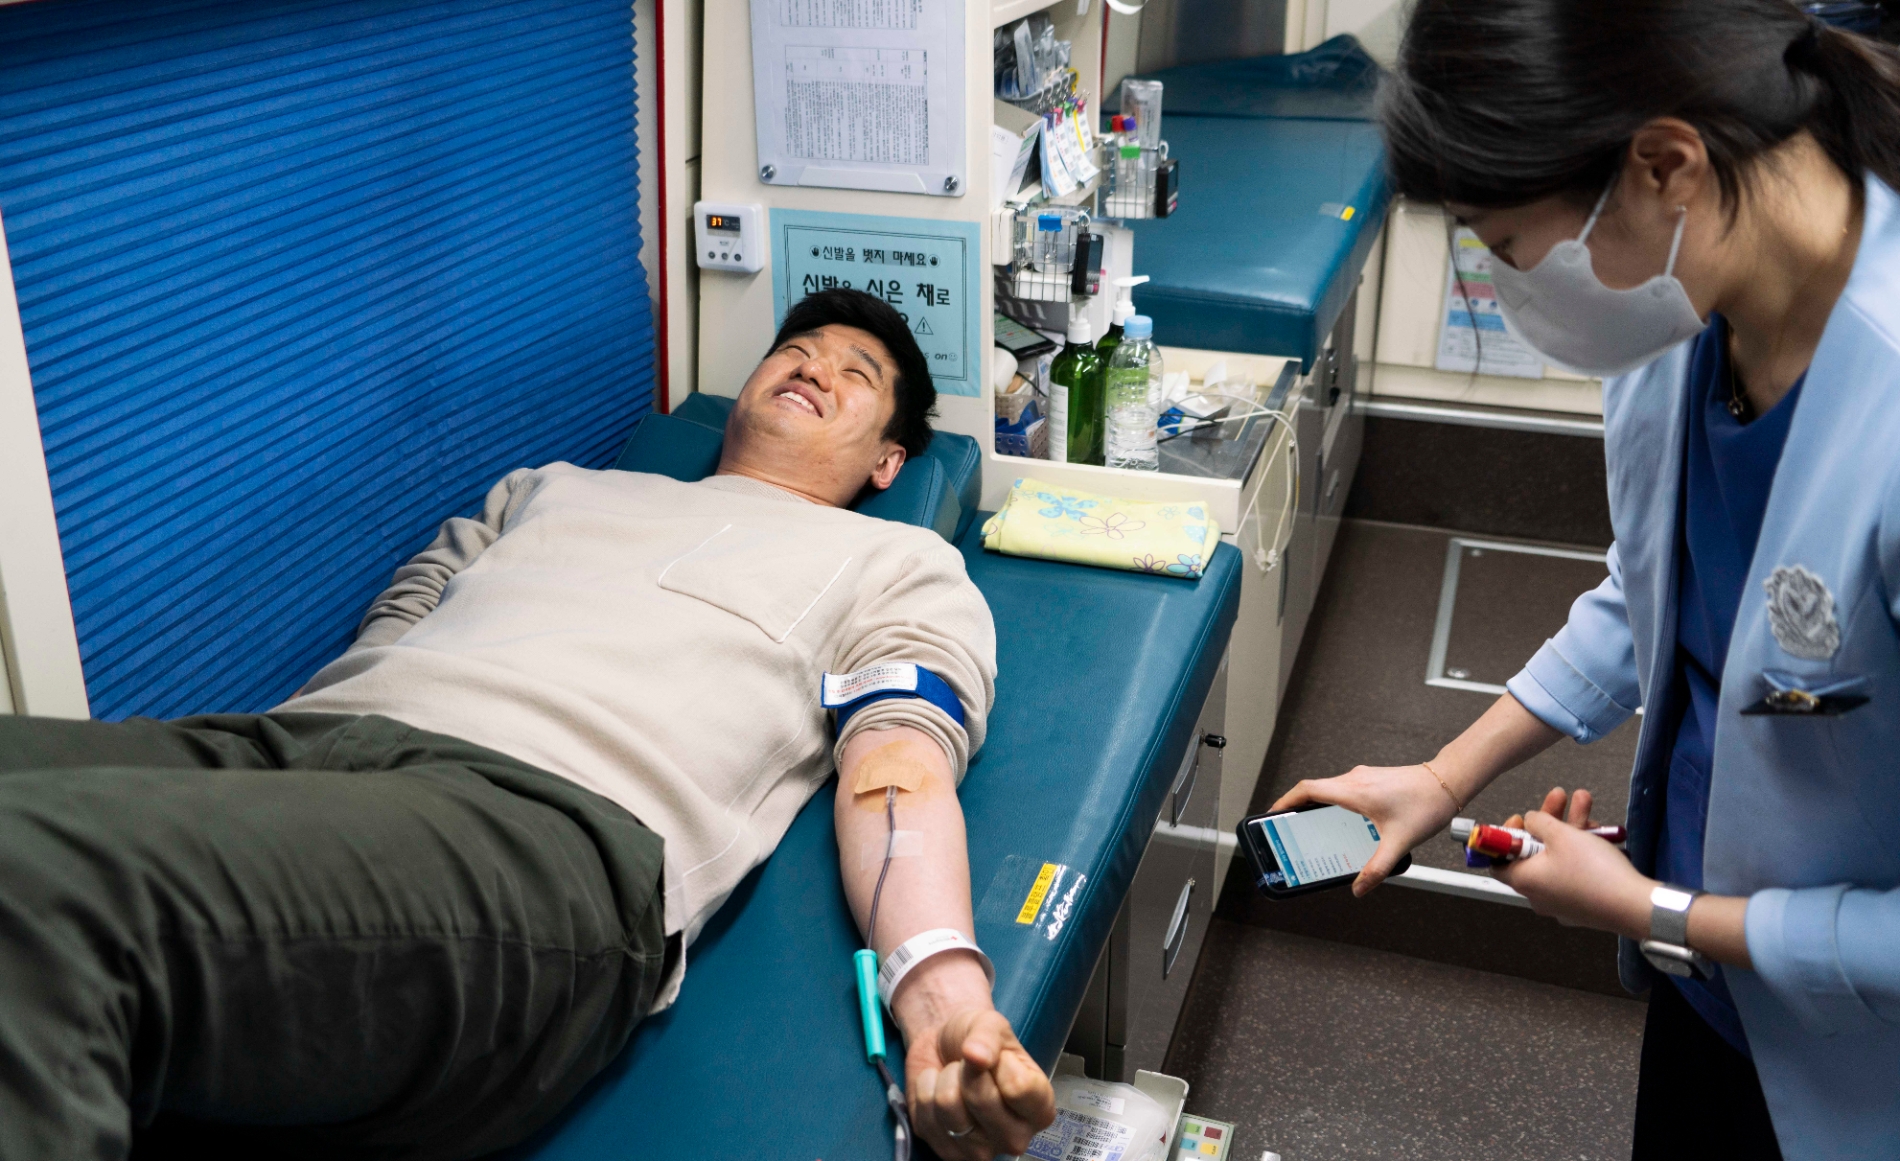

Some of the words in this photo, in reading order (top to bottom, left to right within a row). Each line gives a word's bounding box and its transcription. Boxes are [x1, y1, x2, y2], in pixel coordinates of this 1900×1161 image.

[711, 216, 722, 227] 37
[822, 245, 856, 262] 신발을
[863, 248, 885, 264] 벗지
[892, 250, 927, 267] 마세요
[916, 282, 951, 307] 채로
[934, 353, 948, 361] on
